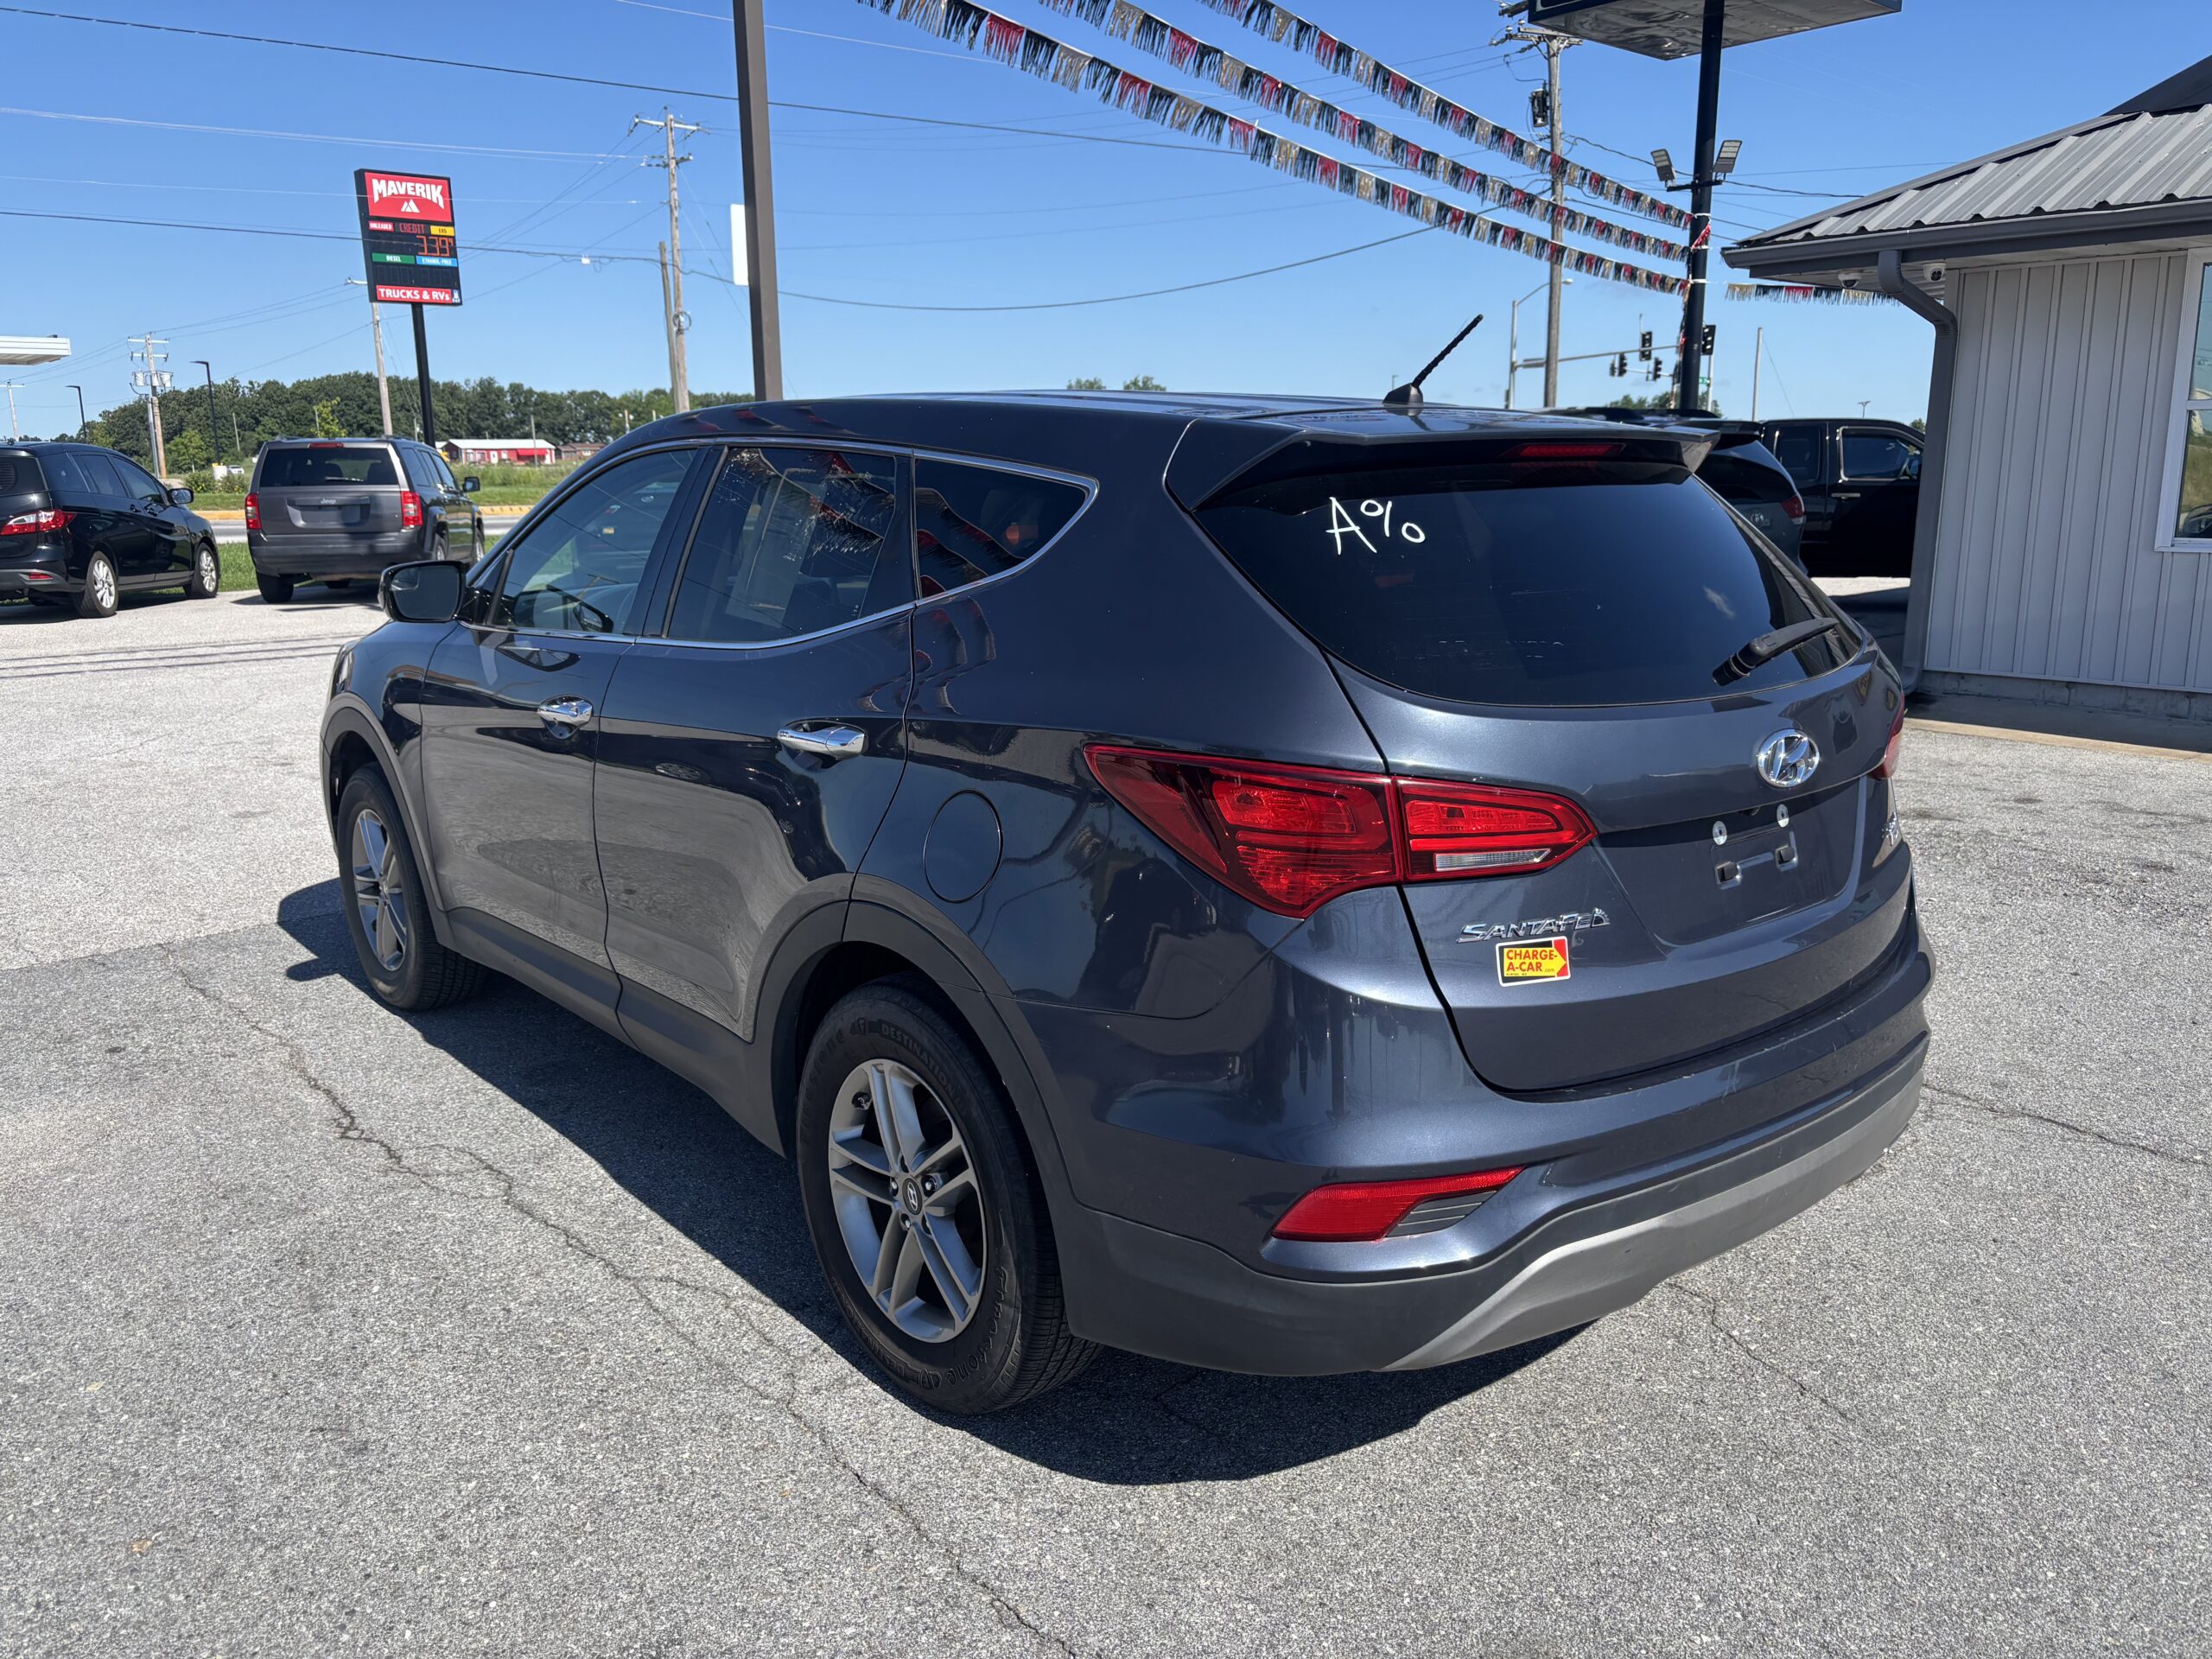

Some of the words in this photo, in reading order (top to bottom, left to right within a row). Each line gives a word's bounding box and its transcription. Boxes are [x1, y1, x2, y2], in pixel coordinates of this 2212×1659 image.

[372, 178, 444, 209] MAVERIK
[399, 222, 425, 234] CREDIT
[378, 288, 421, 300] TRUCKS
[422, 289, 430, 300] &
[431, 291, 450, 301] RVs
[1506, 961, 1543, 972] A-CAR
[880, 1023, 955, 1097] DESTINATION
